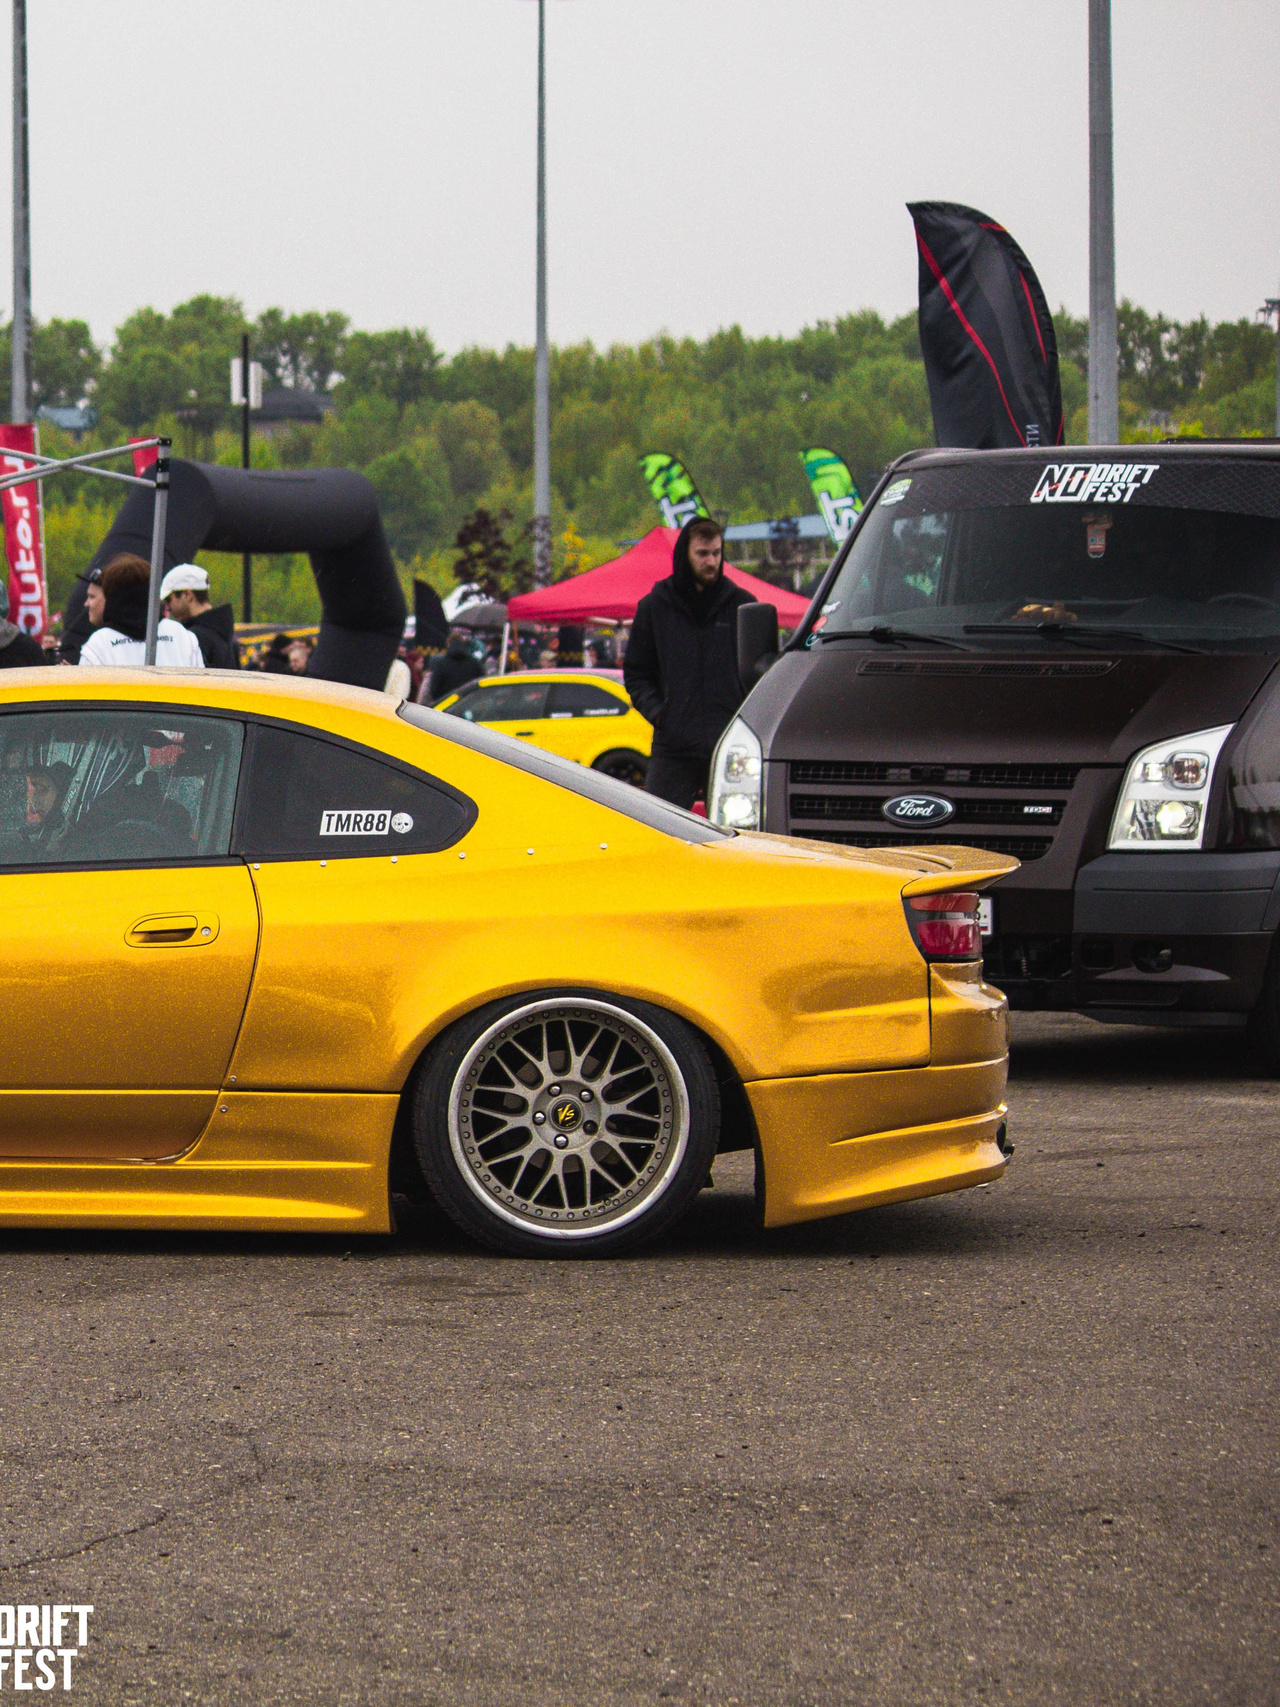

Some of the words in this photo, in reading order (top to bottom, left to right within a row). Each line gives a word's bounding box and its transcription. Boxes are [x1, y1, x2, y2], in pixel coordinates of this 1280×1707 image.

[1090, 464, 1160, 484] DRIFT
[1081, 482, 1141, 503] FEST
[895, 798, 935, 817] Ford
[325, 813, 388, 833] TMR88
